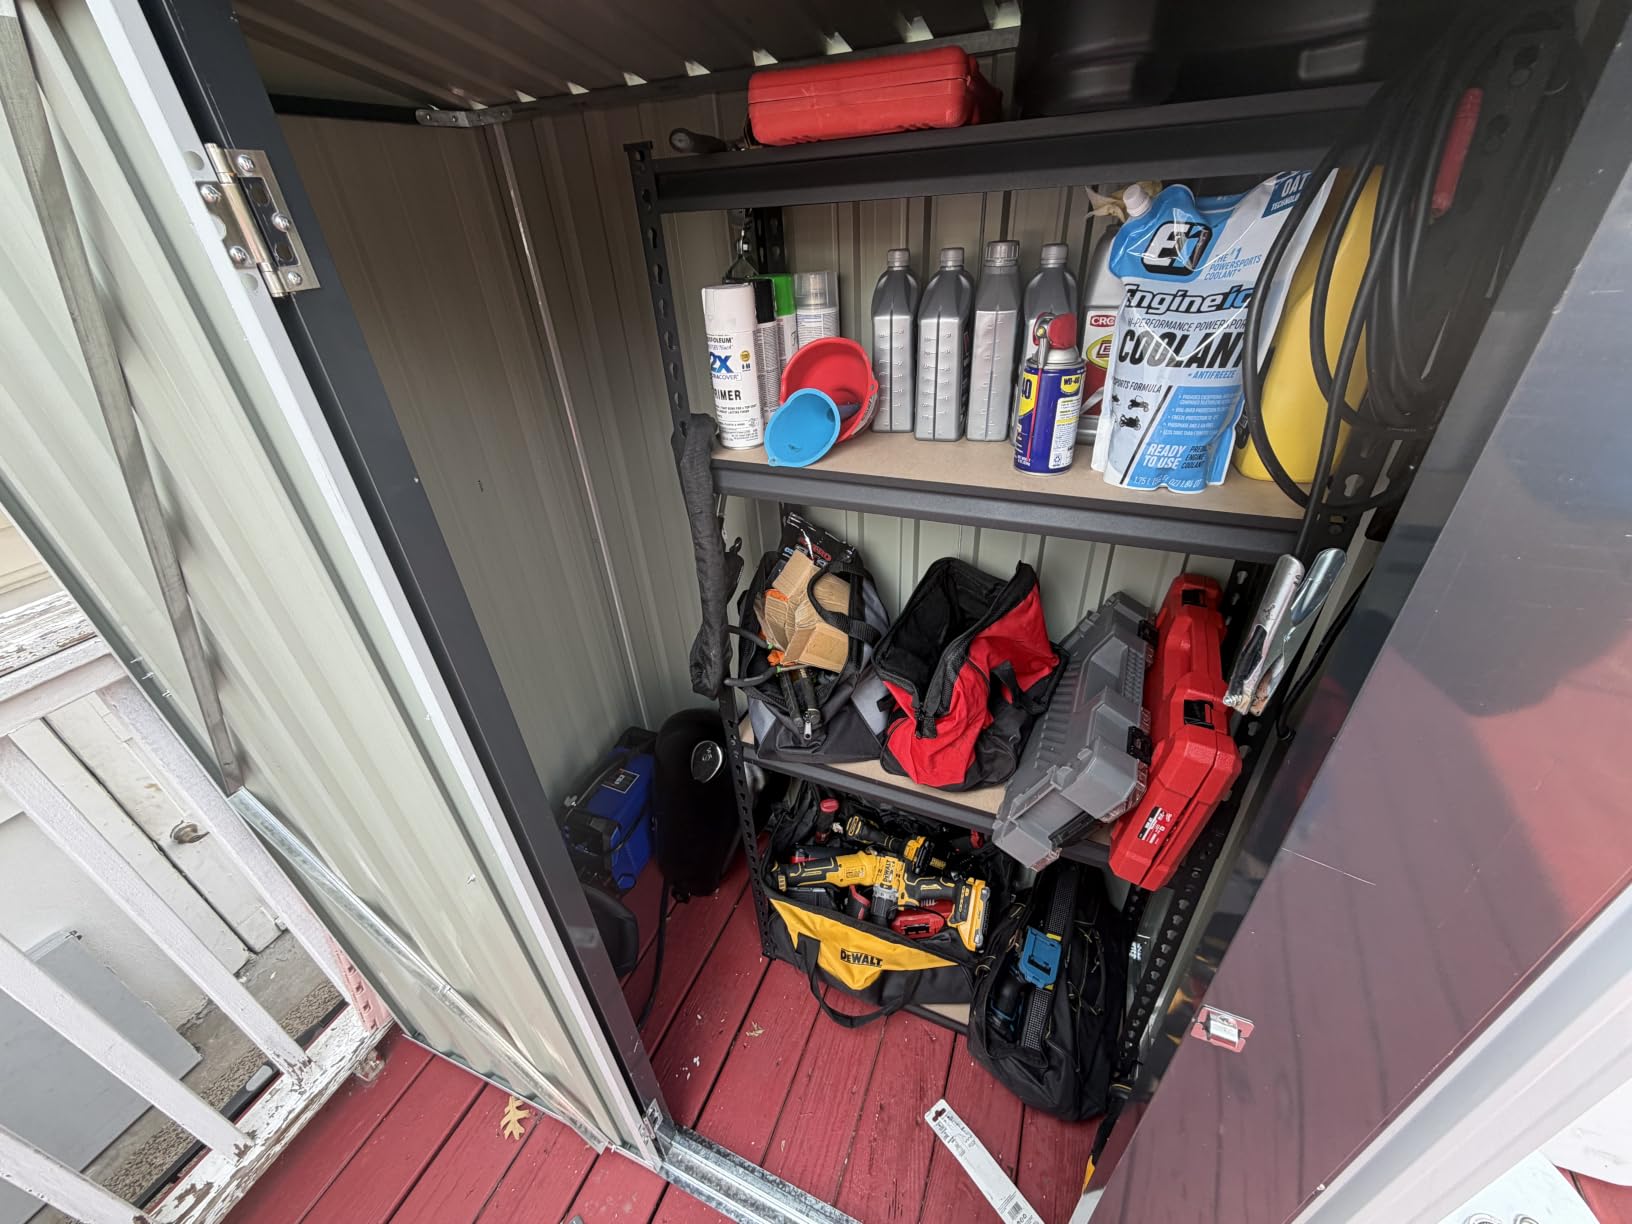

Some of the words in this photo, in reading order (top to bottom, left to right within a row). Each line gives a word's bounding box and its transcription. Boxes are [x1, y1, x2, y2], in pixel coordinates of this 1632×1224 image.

[1281, 173, 1312, 198] OAT
[1209, 255, 1262, 272] POWERSPORTS
[1214, 254, 1229, 263] THE
[1222, 284, 1255, 310] ic
[1193, 318, 1248, 332] POWERSPOR
[710, 352, 734, 374] 2X
[1192, 370, 1237, 380] ANTIFREEZE
[714, 388, 742, 401] RIMER
[1129, 381, 1163, 394] FORMULA
[1147, 443, 1188, 458] READY
[1143, 455, 1156, 467] TO
[1157, 456, 1182, 470] USE
[841, 948, 883, 968] DEWALT
